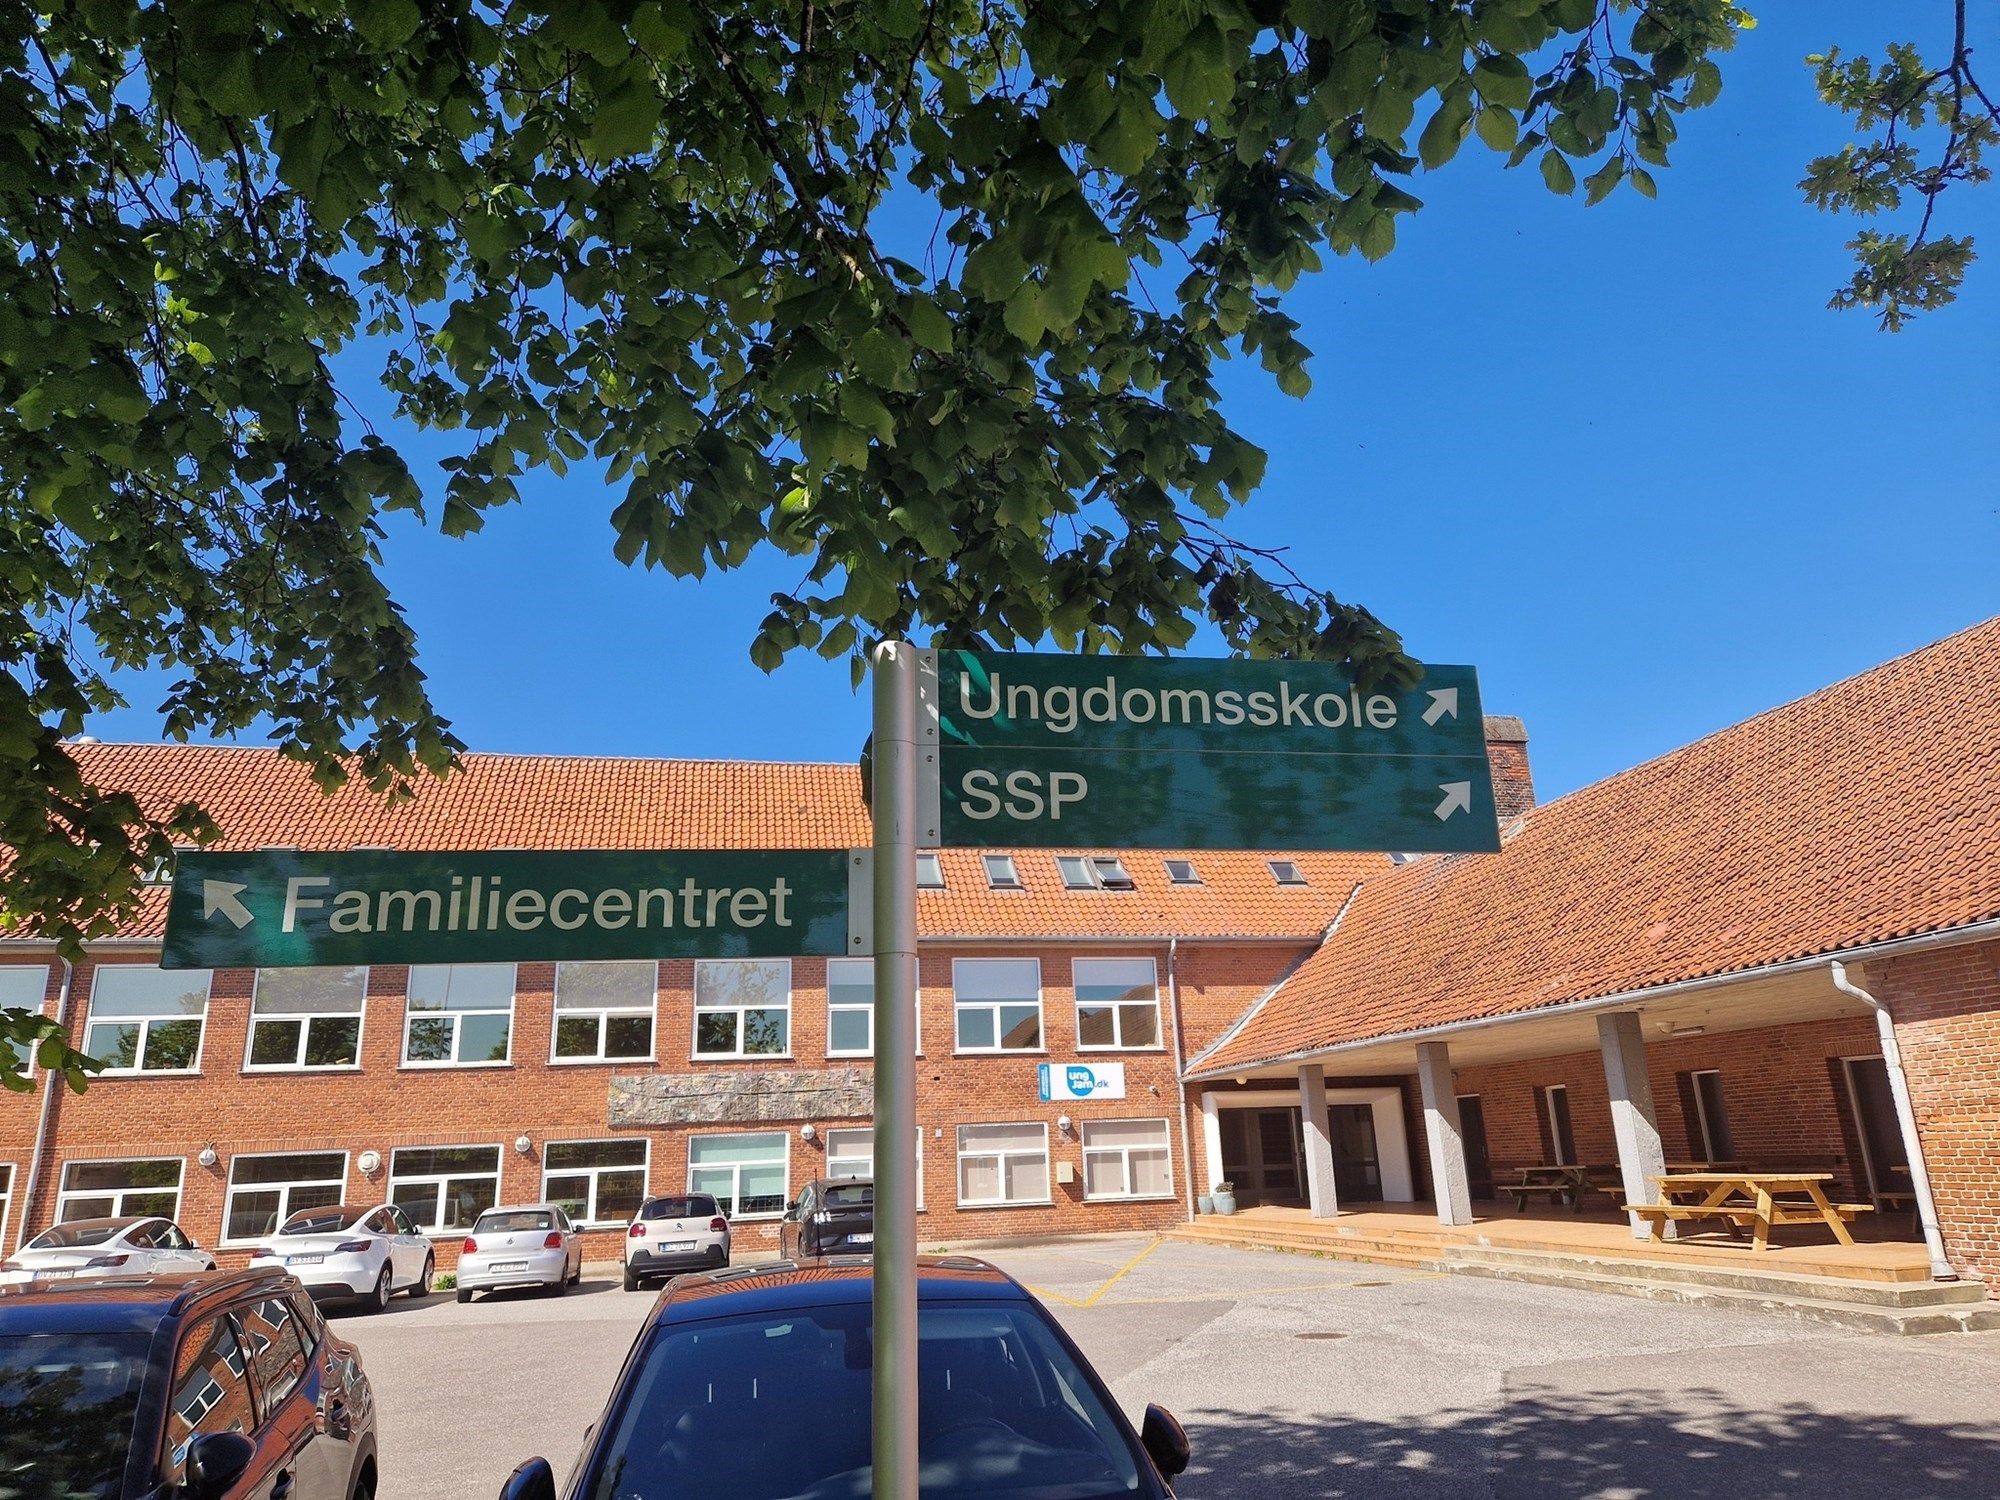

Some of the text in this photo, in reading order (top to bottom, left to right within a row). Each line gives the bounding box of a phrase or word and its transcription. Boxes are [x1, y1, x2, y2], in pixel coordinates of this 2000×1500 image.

[959, 671, 1399, 733] Ungdomsskole
[959, 769, 1089, 821] SSP
[280, 875, 793, 933] Familiecentret
[1068, 1071, 1090, 1081] ung
